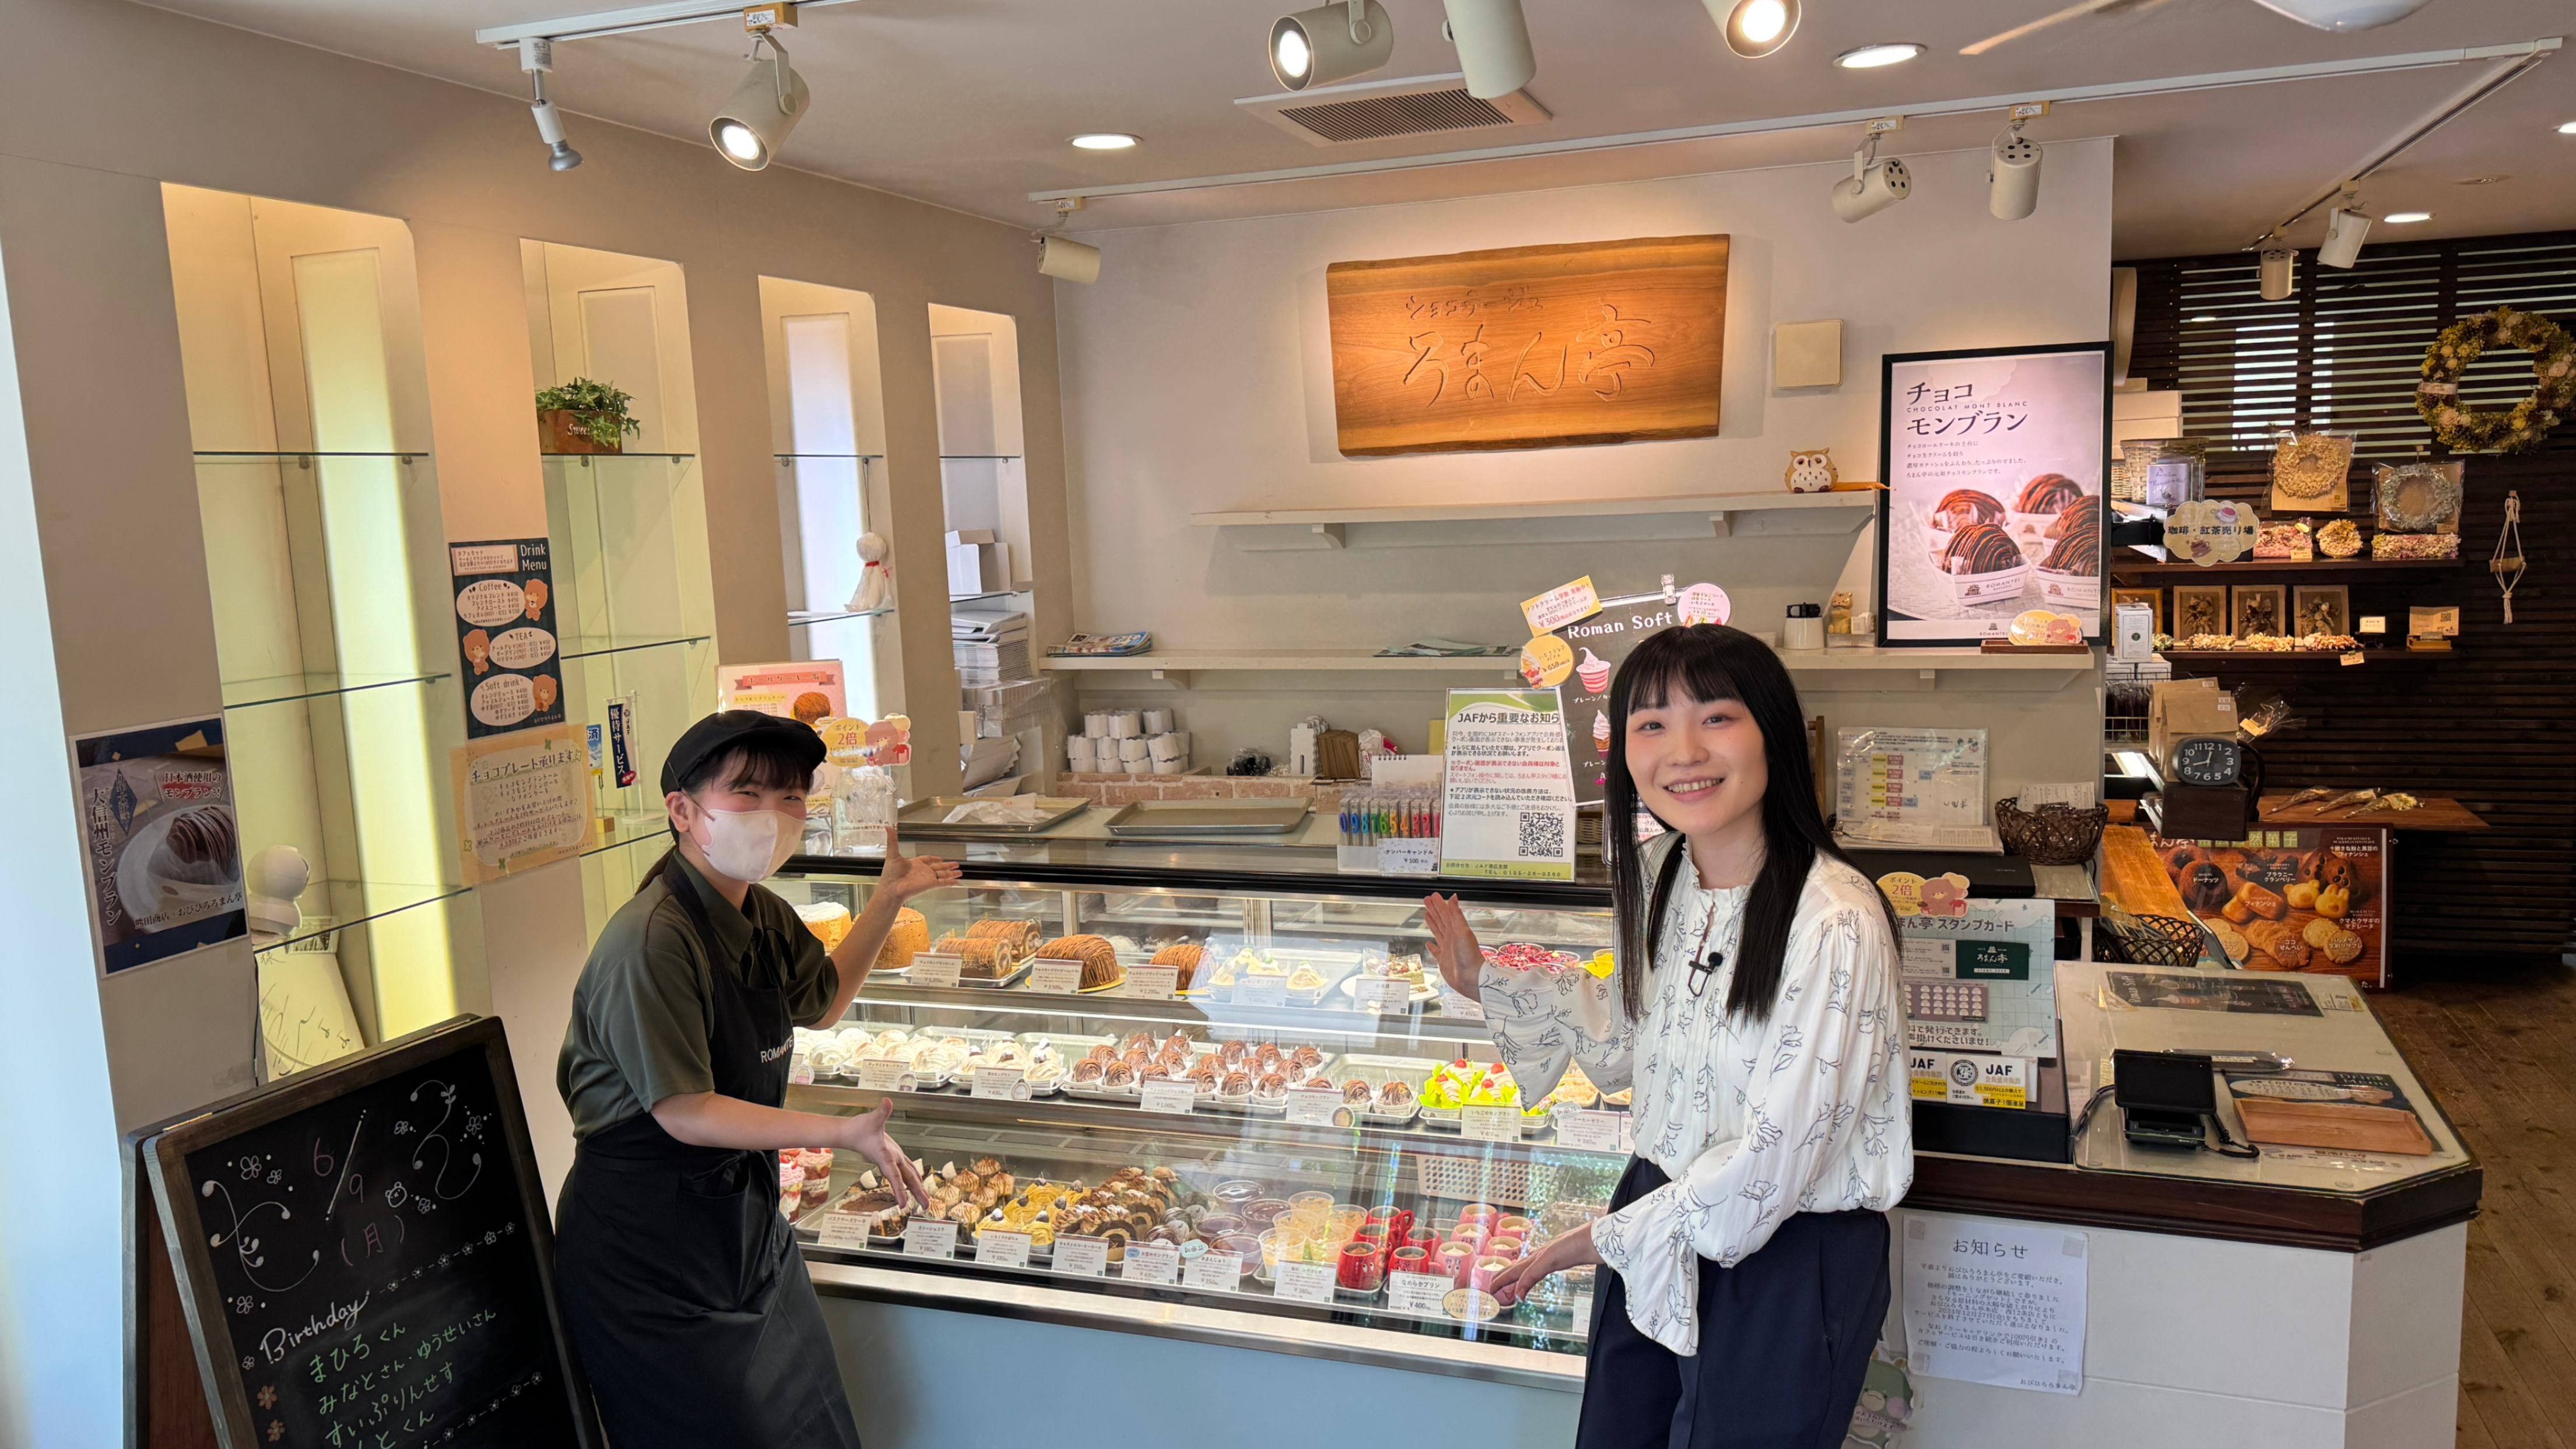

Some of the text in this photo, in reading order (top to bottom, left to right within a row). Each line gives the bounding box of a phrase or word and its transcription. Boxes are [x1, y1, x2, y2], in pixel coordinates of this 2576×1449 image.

[1402, 302, 1655, 408] ろまん亭
[1907, 382, 1973, 405] チョコ
[1907, 405, 1958, 413] CHOCOLAT
[1907, 410, 2028, 436] モンブラン
[2168, 525, 2254, 535] 珈琲・紅茶売り場
[520, 543, 546, 557] Drink
[522, 560, 547, 571] Menu
[479, 583, 502, 591] Coffee
[1986, 578, 2020, 588] ROMANTEI
[1568, 612, 1672, 639] Roman Soft
[515, 633, 528, 641] TEA
[485, 678, 520, 690] Soft drink
[1458, 713, 1560, 724] JAFから重要なお知ら
[610, 707, 626, 775] 優待サービス
[838, 732, 857, 745] 2倍
[471, 750, 573, 784] チョコプレート承ります
[2184, 767, 2191, 775] 8
[2224, 767, 2231, 776] 4
[164, 771, 222, 784] 日本酒使用の
[90, 788, 121, 926] 大信州モンブラン
[1892, 885, 1913, 896] 2倍
[1938, 919, 2014, 932] スタンプカード
[1977, 953, 2008, 964] ろまん亭
[1911, 1058, 1935, 1069] JAF
[1986, 1064, 2013, 1076] JAF
[1953, 1239, 2028, 1259] お知らせ
[1402, 1279, 1440, 1288] なめらかプリン
[1409, 1301, 1426, 1309] ¥400
[259, 1290, 370, 1364] Birthday
[2020, 1379, 2076, 1391] おびひろろまん亭
